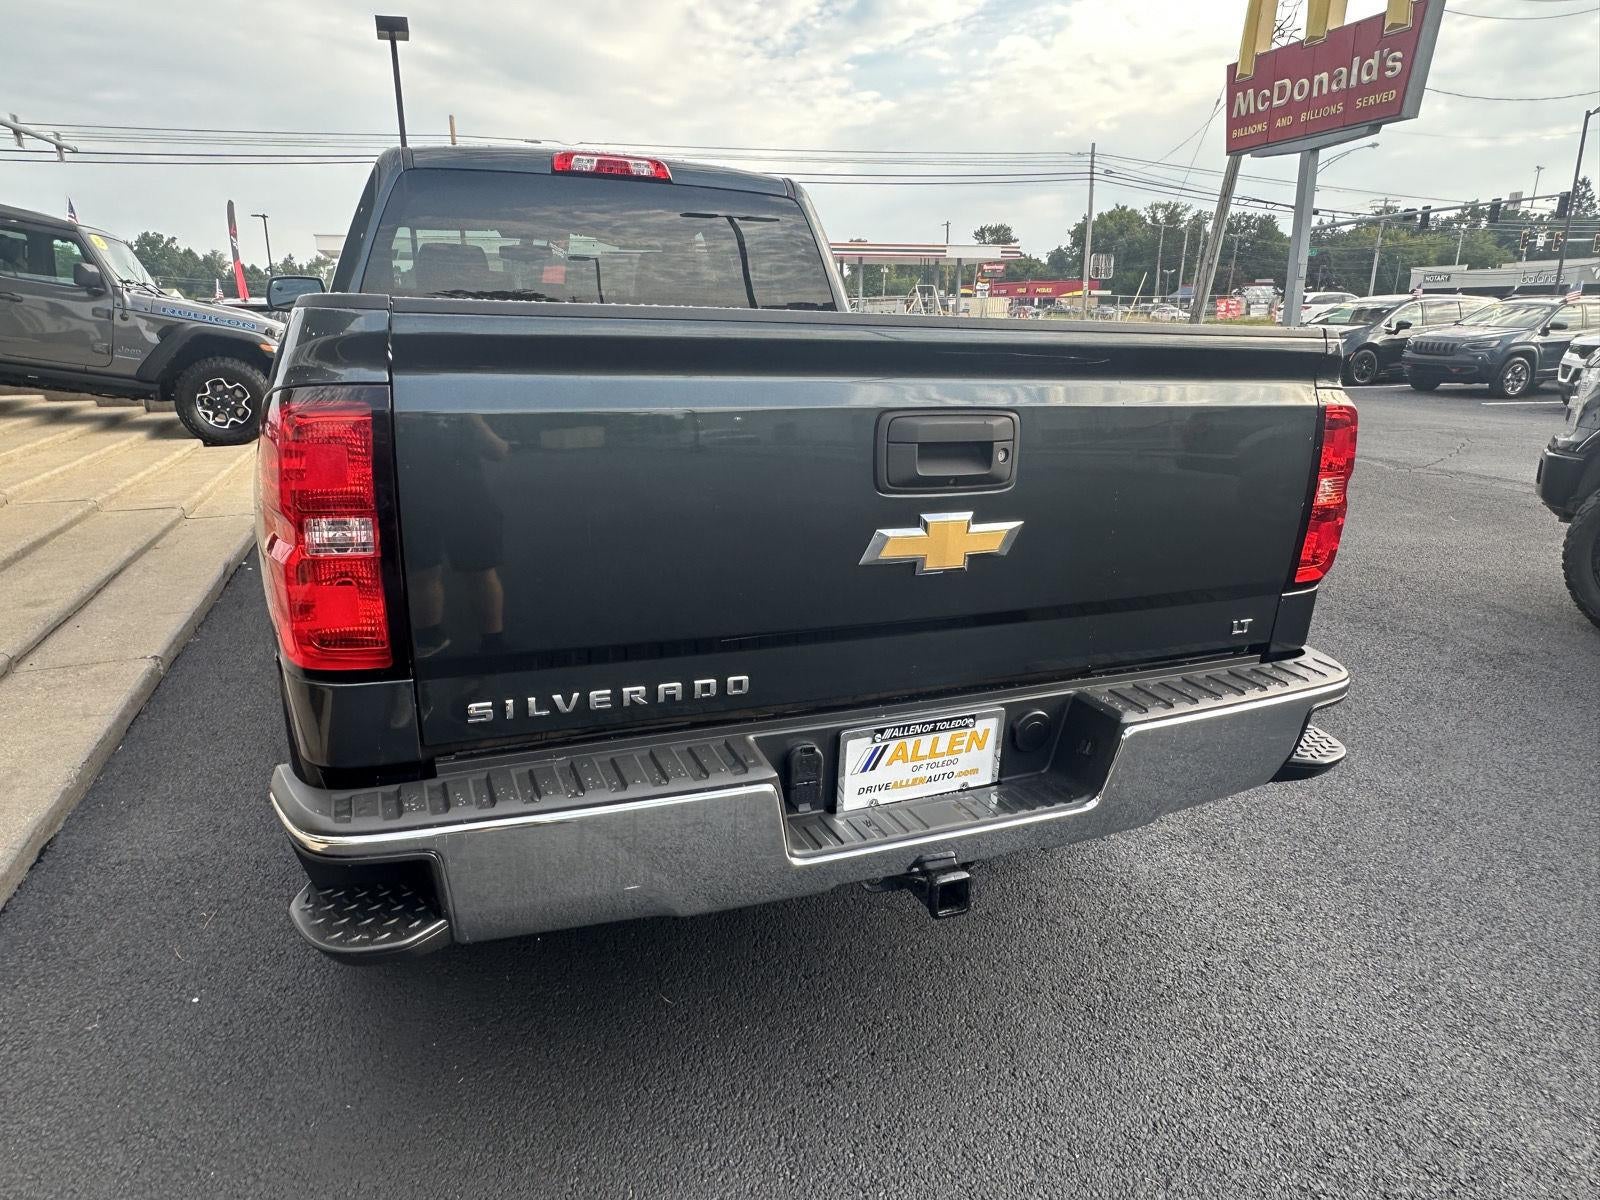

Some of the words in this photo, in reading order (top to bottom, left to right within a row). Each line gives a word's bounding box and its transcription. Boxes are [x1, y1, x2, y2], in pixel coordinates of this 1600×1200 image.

[1232, 48, 1403, 118] McDonald's
[1232, 122, 1267, 138] BILLIONS
[1275, 115, 1293, 128] AND
[1300, 102, 1344, 122] BILLIONS
[1355, 89, 1397, 109] SERVED
[160, 306, 257, 330] RUBICON
[1231, 618, 1254, 635] LT
[467, 675, 749, 723] SILVERADO
[892, 727, 921, 738] ALLEN
[922, 723, 934, 733] OF
[936, 718, 967, 731] TOLEDO
[885, 728, 991, 767] ALLEN
[911, 763, 924, 773] OF
[926, 757, 959, 770] TOLEDO
